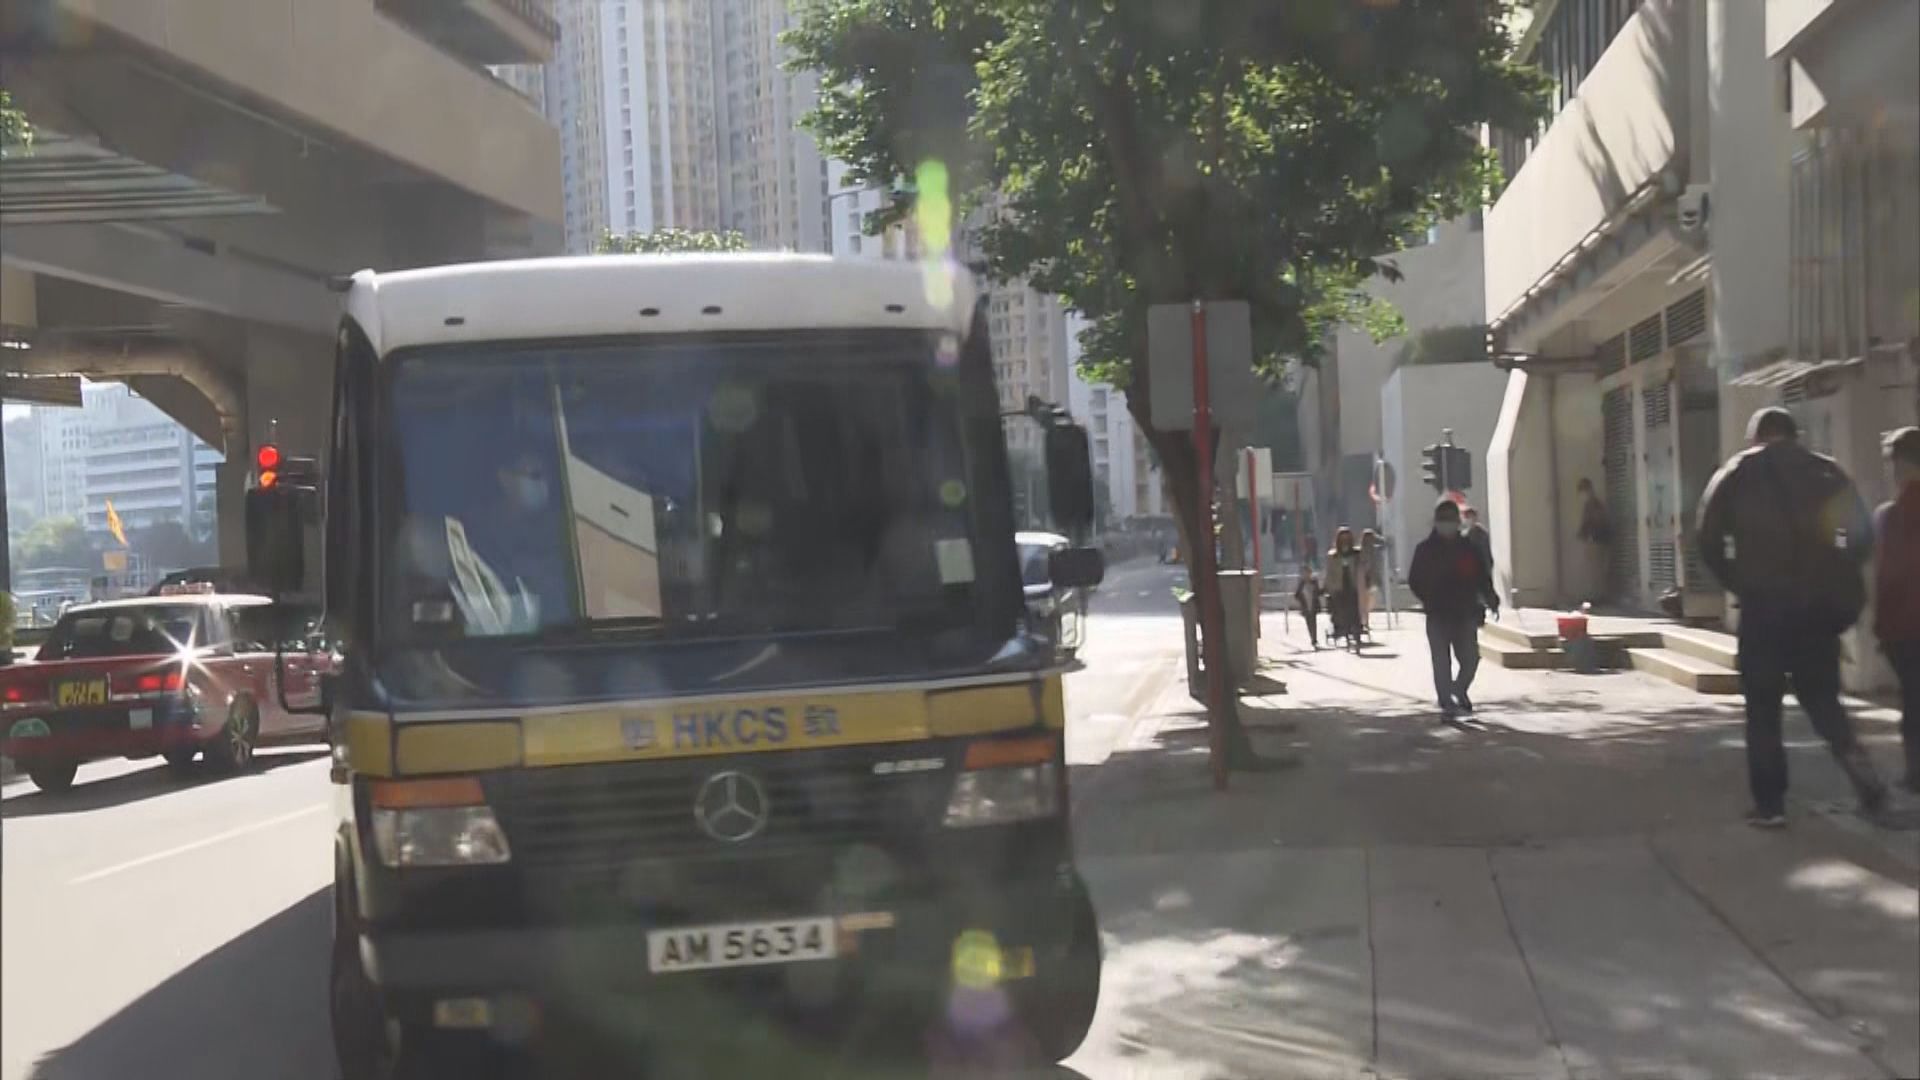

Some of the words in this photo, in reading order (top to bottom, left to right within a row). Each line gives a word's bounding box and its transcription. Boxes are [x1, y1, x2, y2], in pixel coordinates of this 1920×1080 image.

[673, 706, 788, 748] HKCS
[661, 932, 711, 964] AM
[724, 924, 823, 960] 5634
